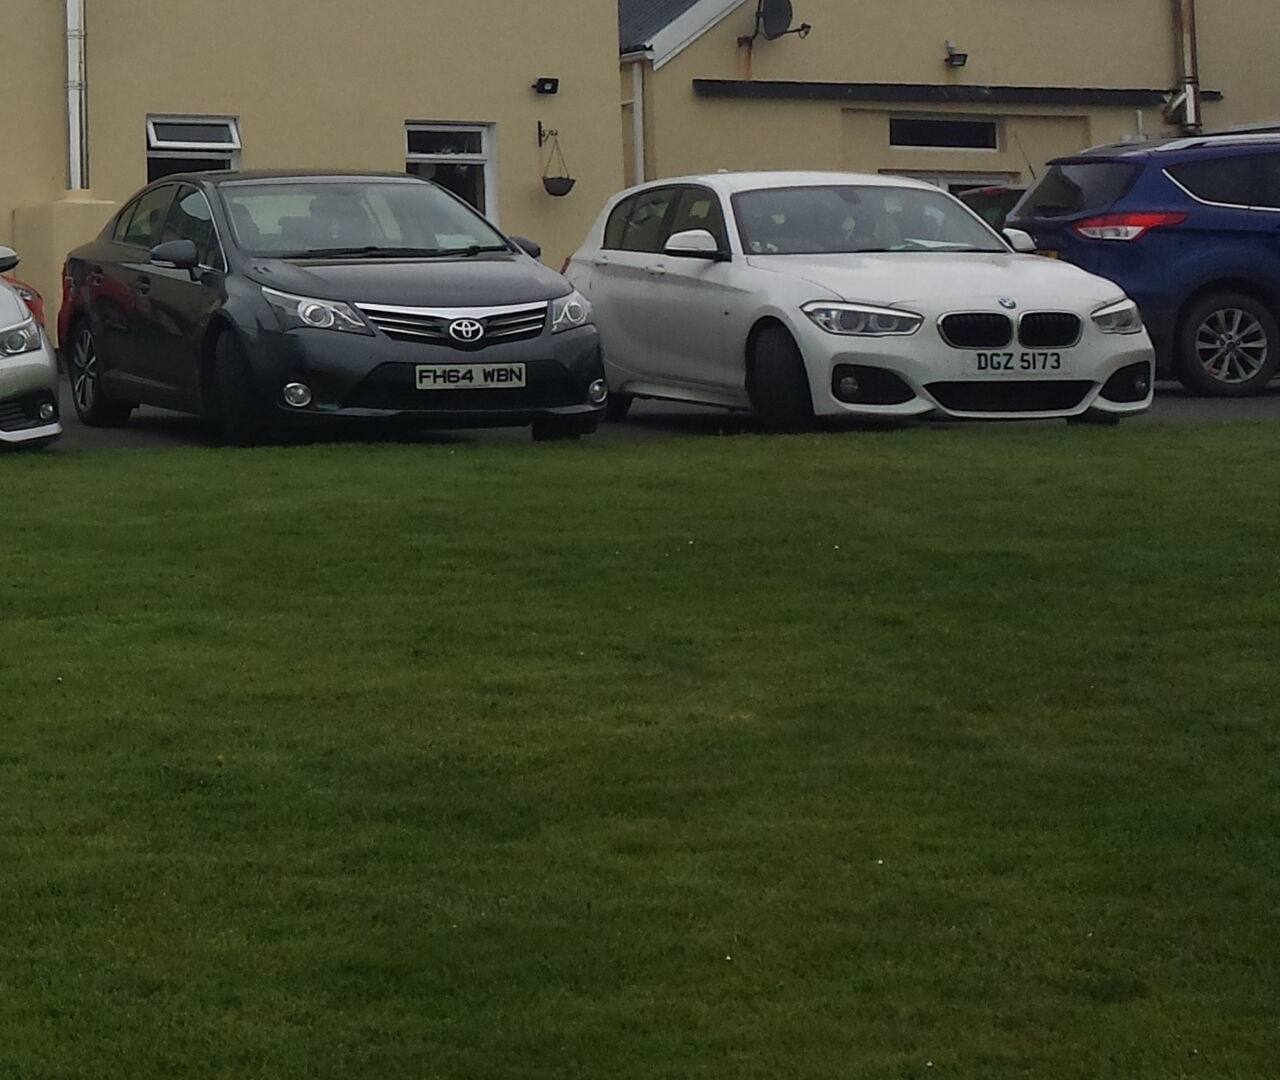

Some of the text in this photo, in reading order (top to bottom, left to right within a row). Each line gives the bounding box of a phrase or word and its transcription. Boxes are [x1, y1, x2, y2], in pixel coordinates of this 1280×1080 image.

[976, 352, 1061, 370] DGZ 5173
[419, 368, 523, 384] FH64 WBN
